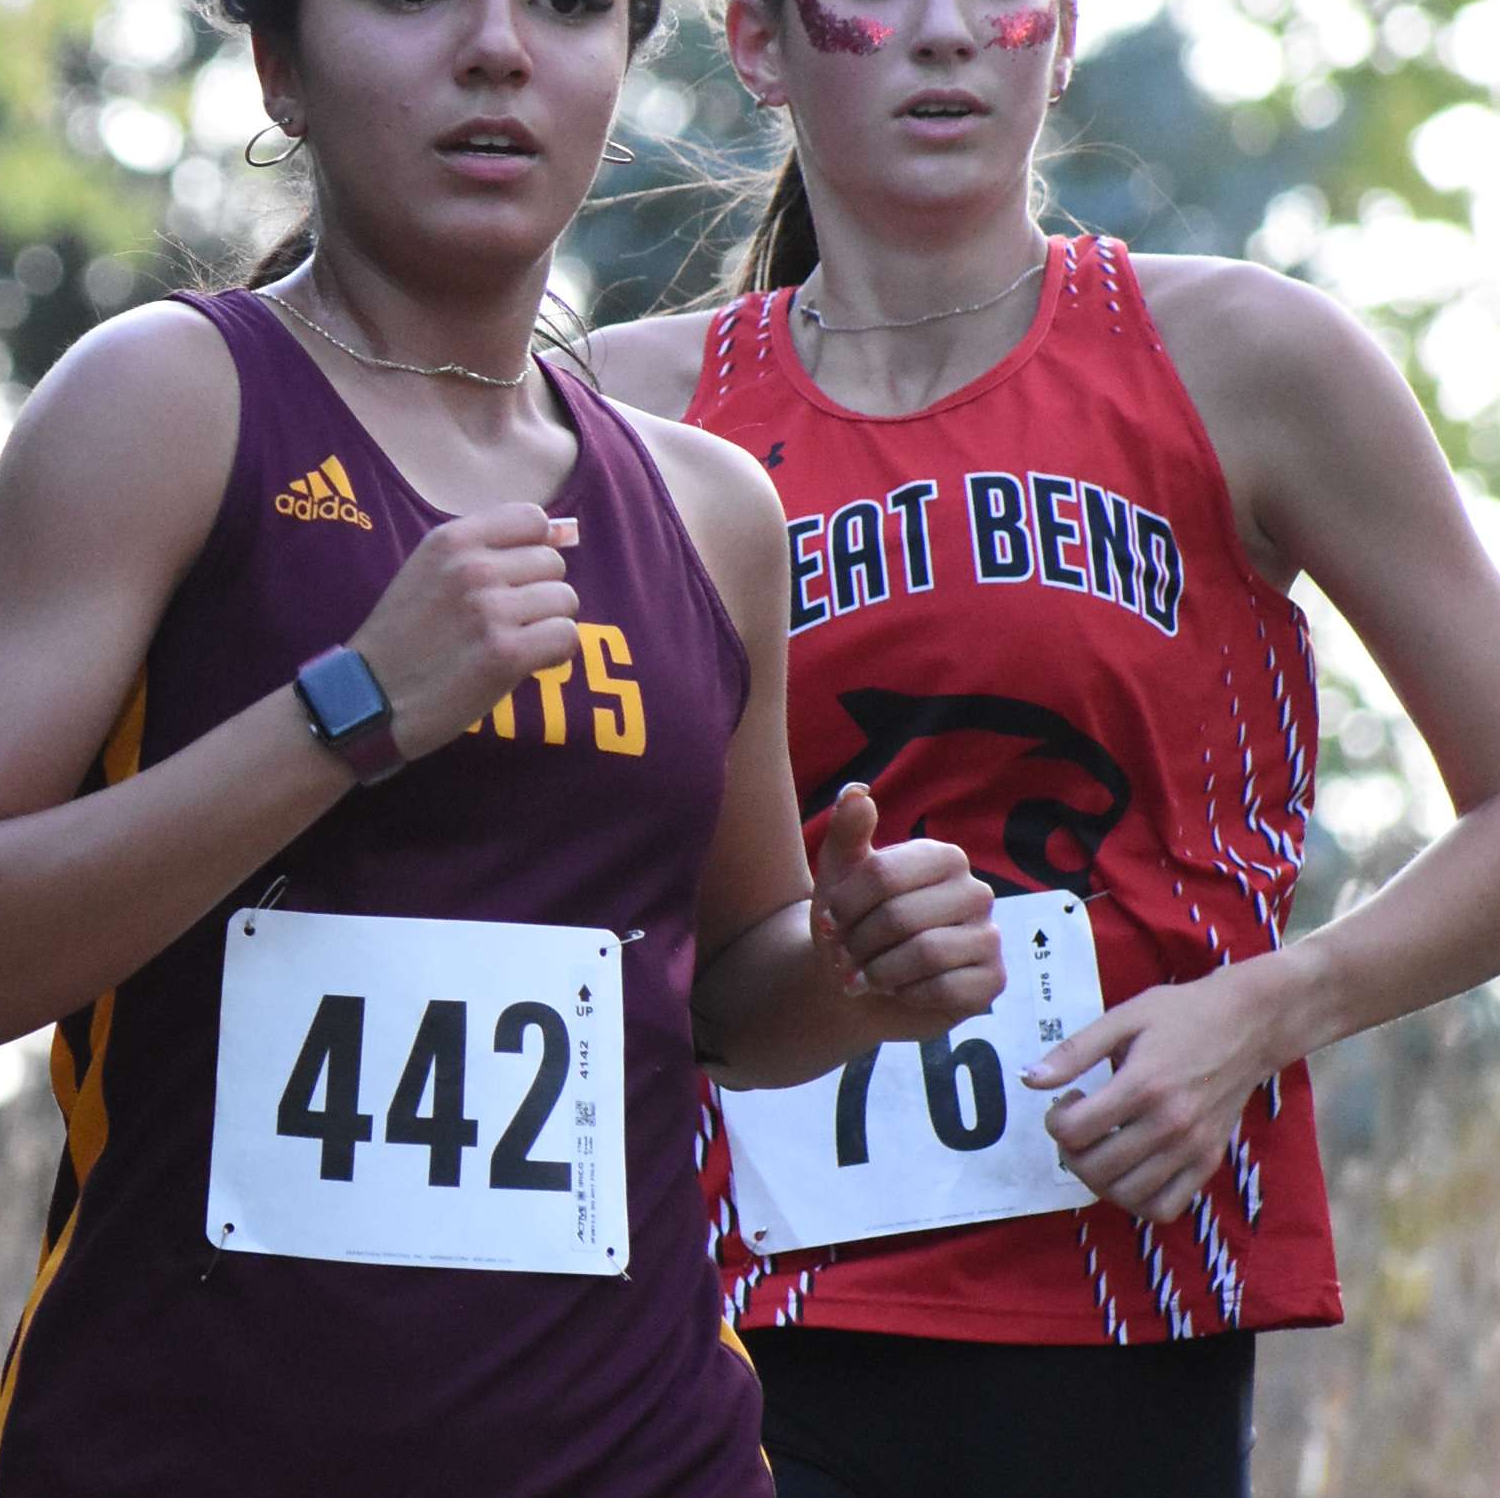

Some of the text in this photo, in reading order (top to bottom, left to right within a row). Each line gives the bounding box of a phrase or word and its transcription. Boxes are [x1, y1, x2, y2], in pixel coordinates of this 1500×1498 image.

[275, 494, 372, 530] adidas
[787, 470, 1185, 638] EAT BEND
[1034, 949, 1051, 960] UP
[576, 1005, 594, 1017] UP
[579, 1040, 589, 1079] 4142
[275, 993, 573, 1193] 442
